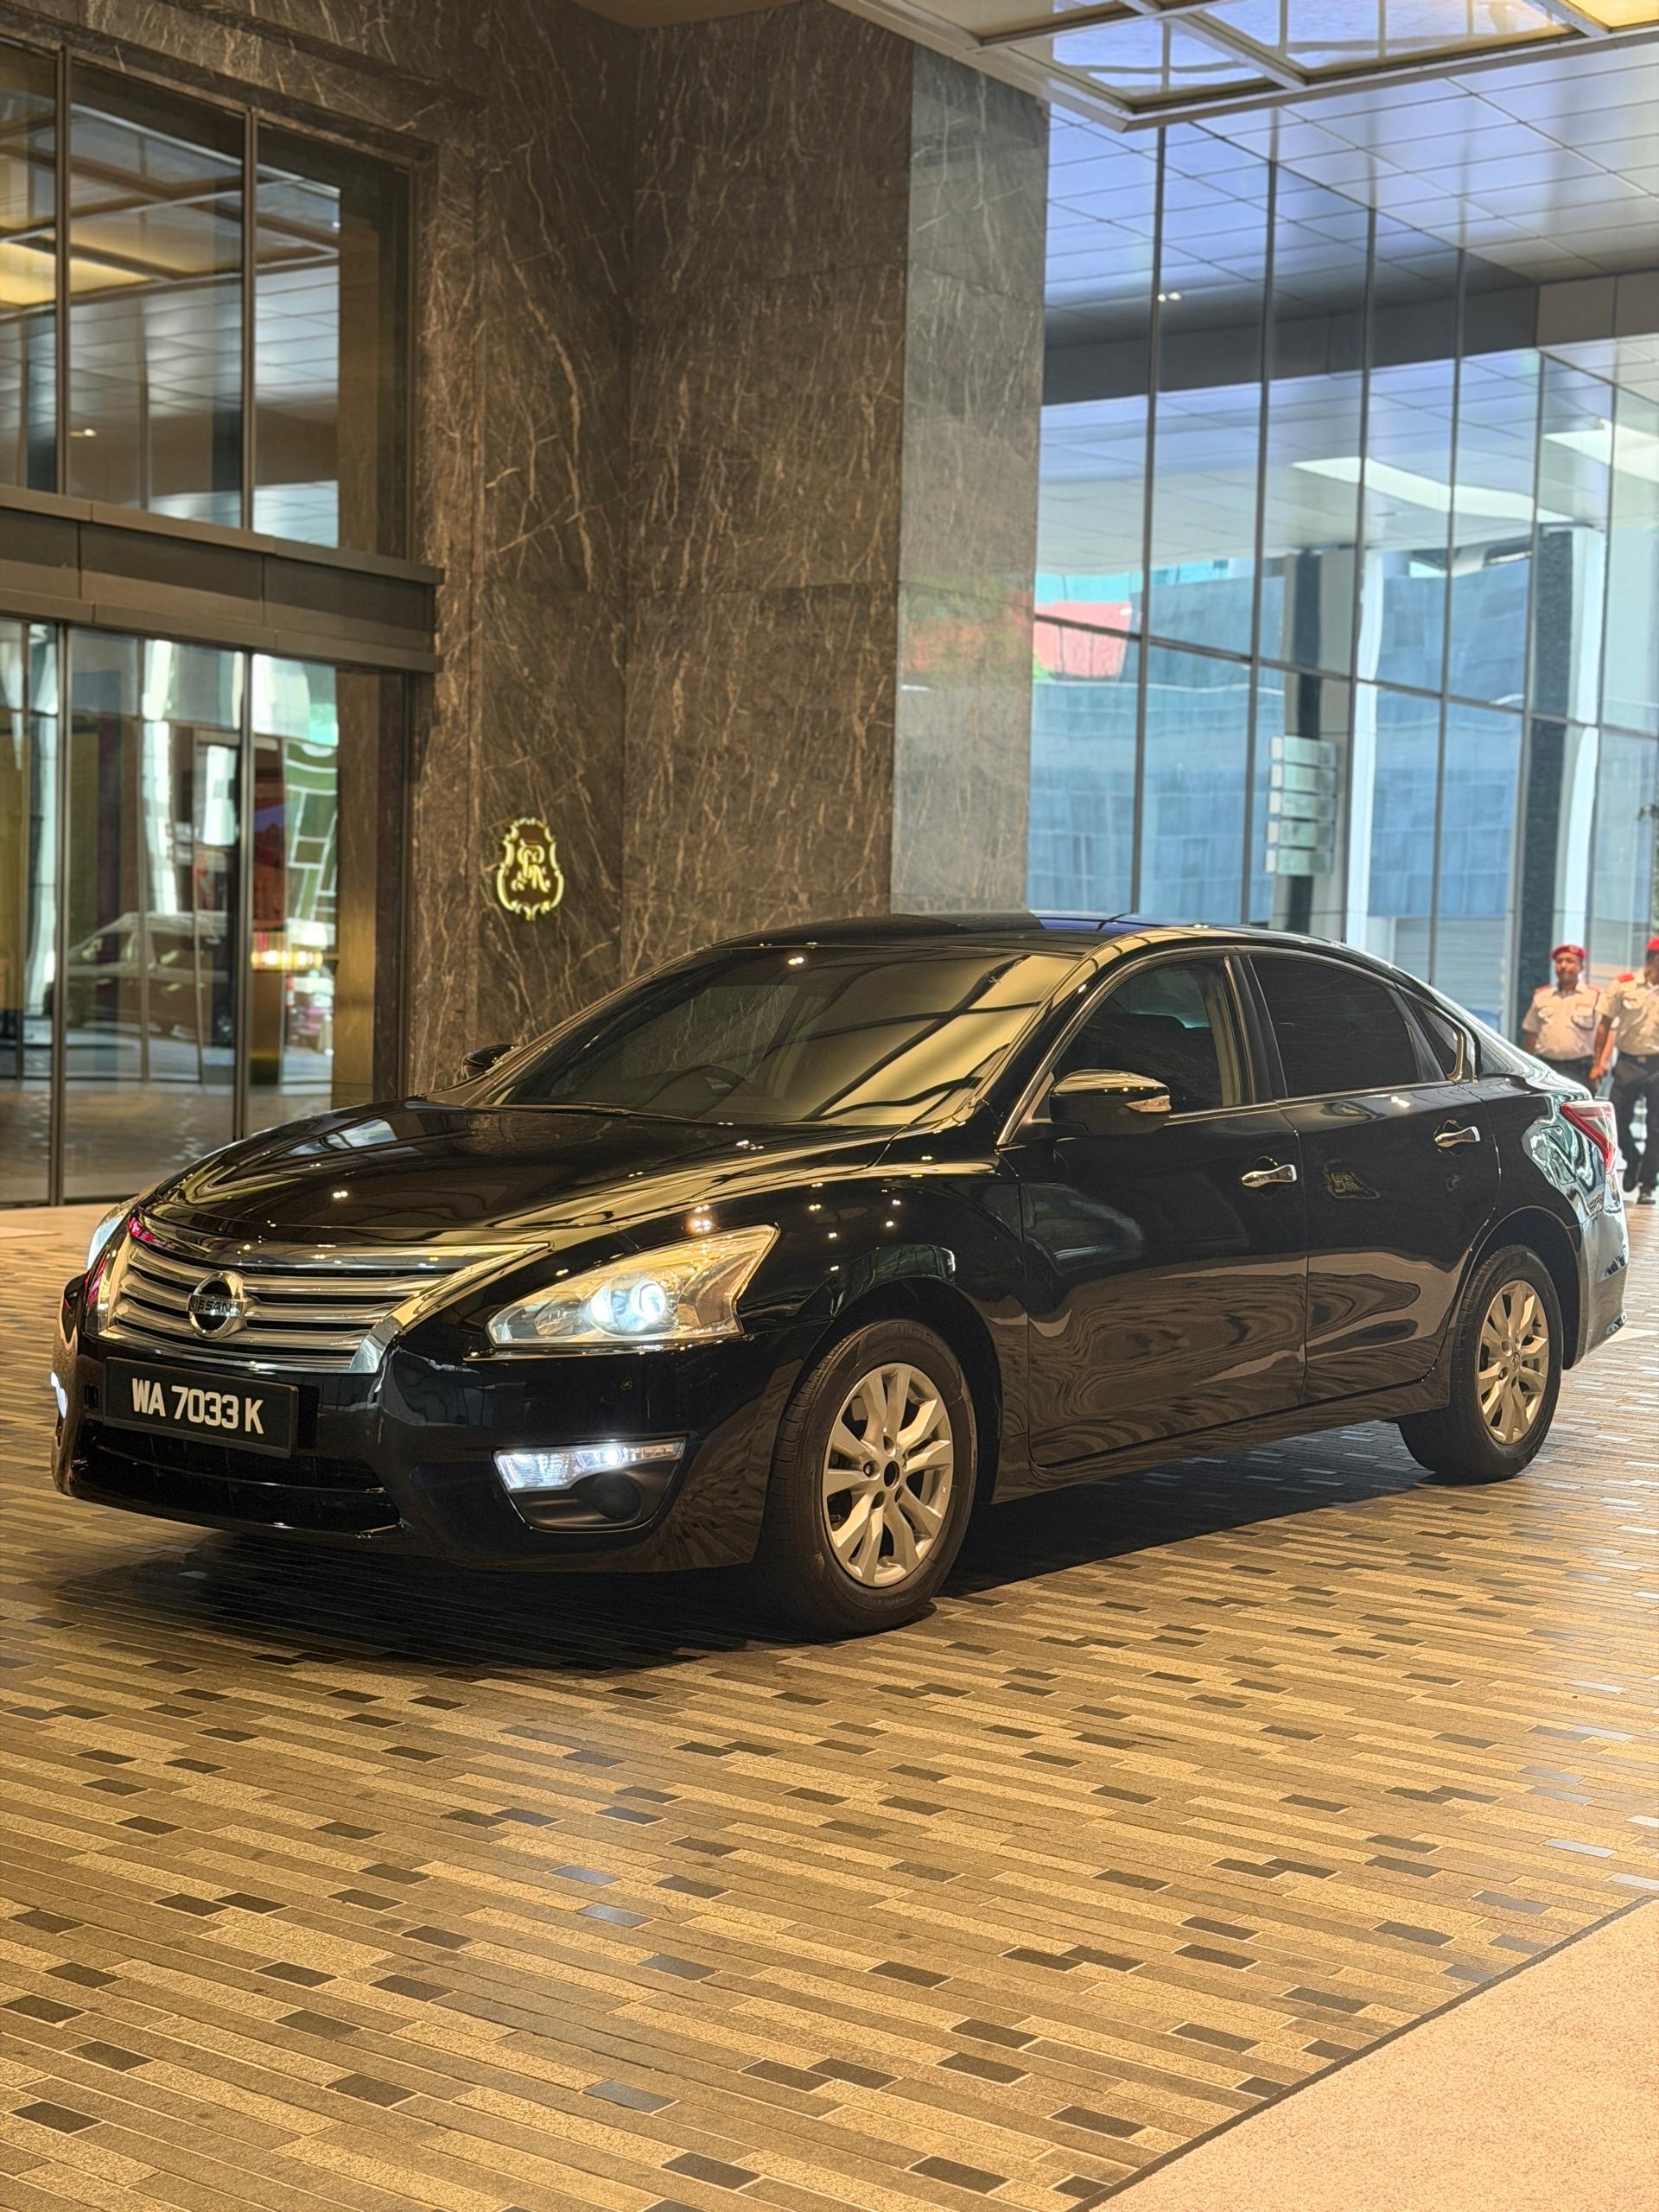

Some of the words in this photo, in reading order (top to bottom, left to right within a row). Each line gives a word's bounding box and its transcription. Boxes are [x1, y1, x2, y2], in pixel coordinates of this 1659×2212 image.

[189, 1298, 232, 1313] NISSAN
[131, 1377, 167, 1418] WA
[171, 1384, 240, 1430] 7033
[245, 1397, 264, 1435] K
